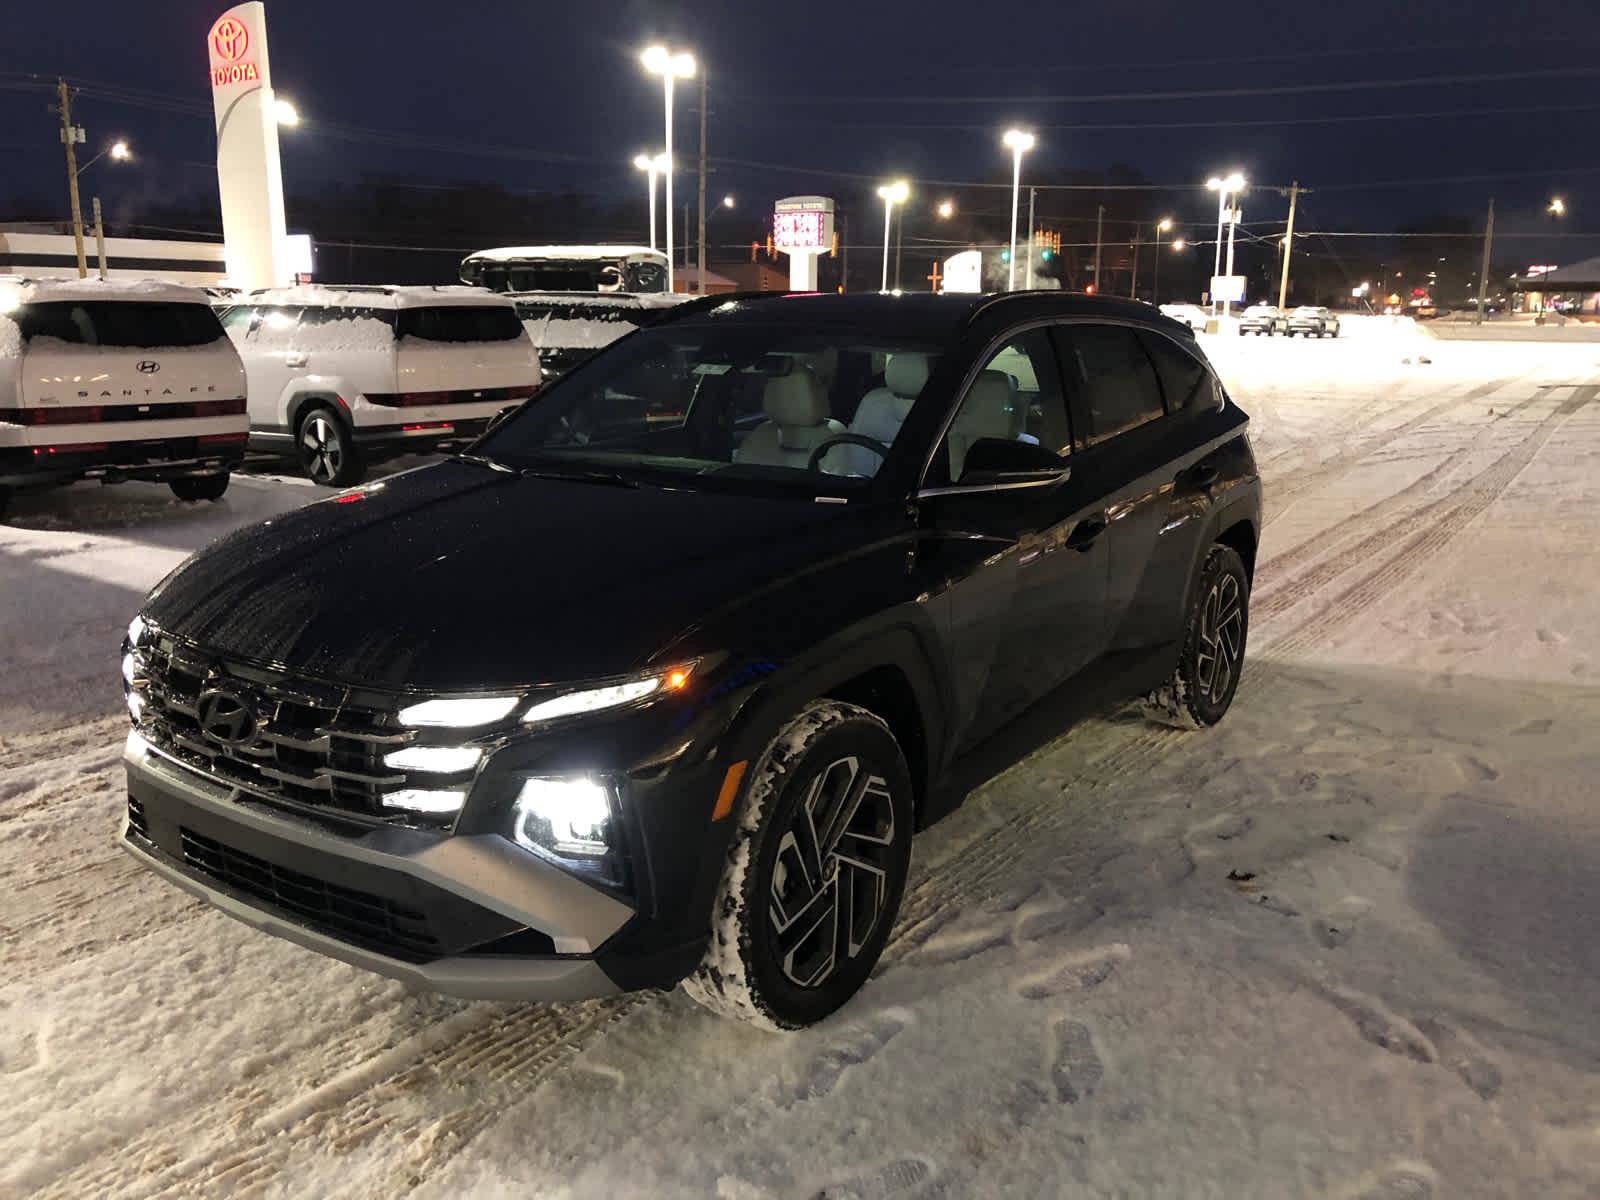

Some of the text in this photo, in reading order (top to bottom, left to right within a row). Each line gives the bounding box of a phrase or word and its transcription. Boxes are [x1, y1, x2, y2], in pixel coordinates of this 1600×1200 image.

[211, 63, 259, 86] TOYOTA
[77, 384, 216, 398] SANTA FE
